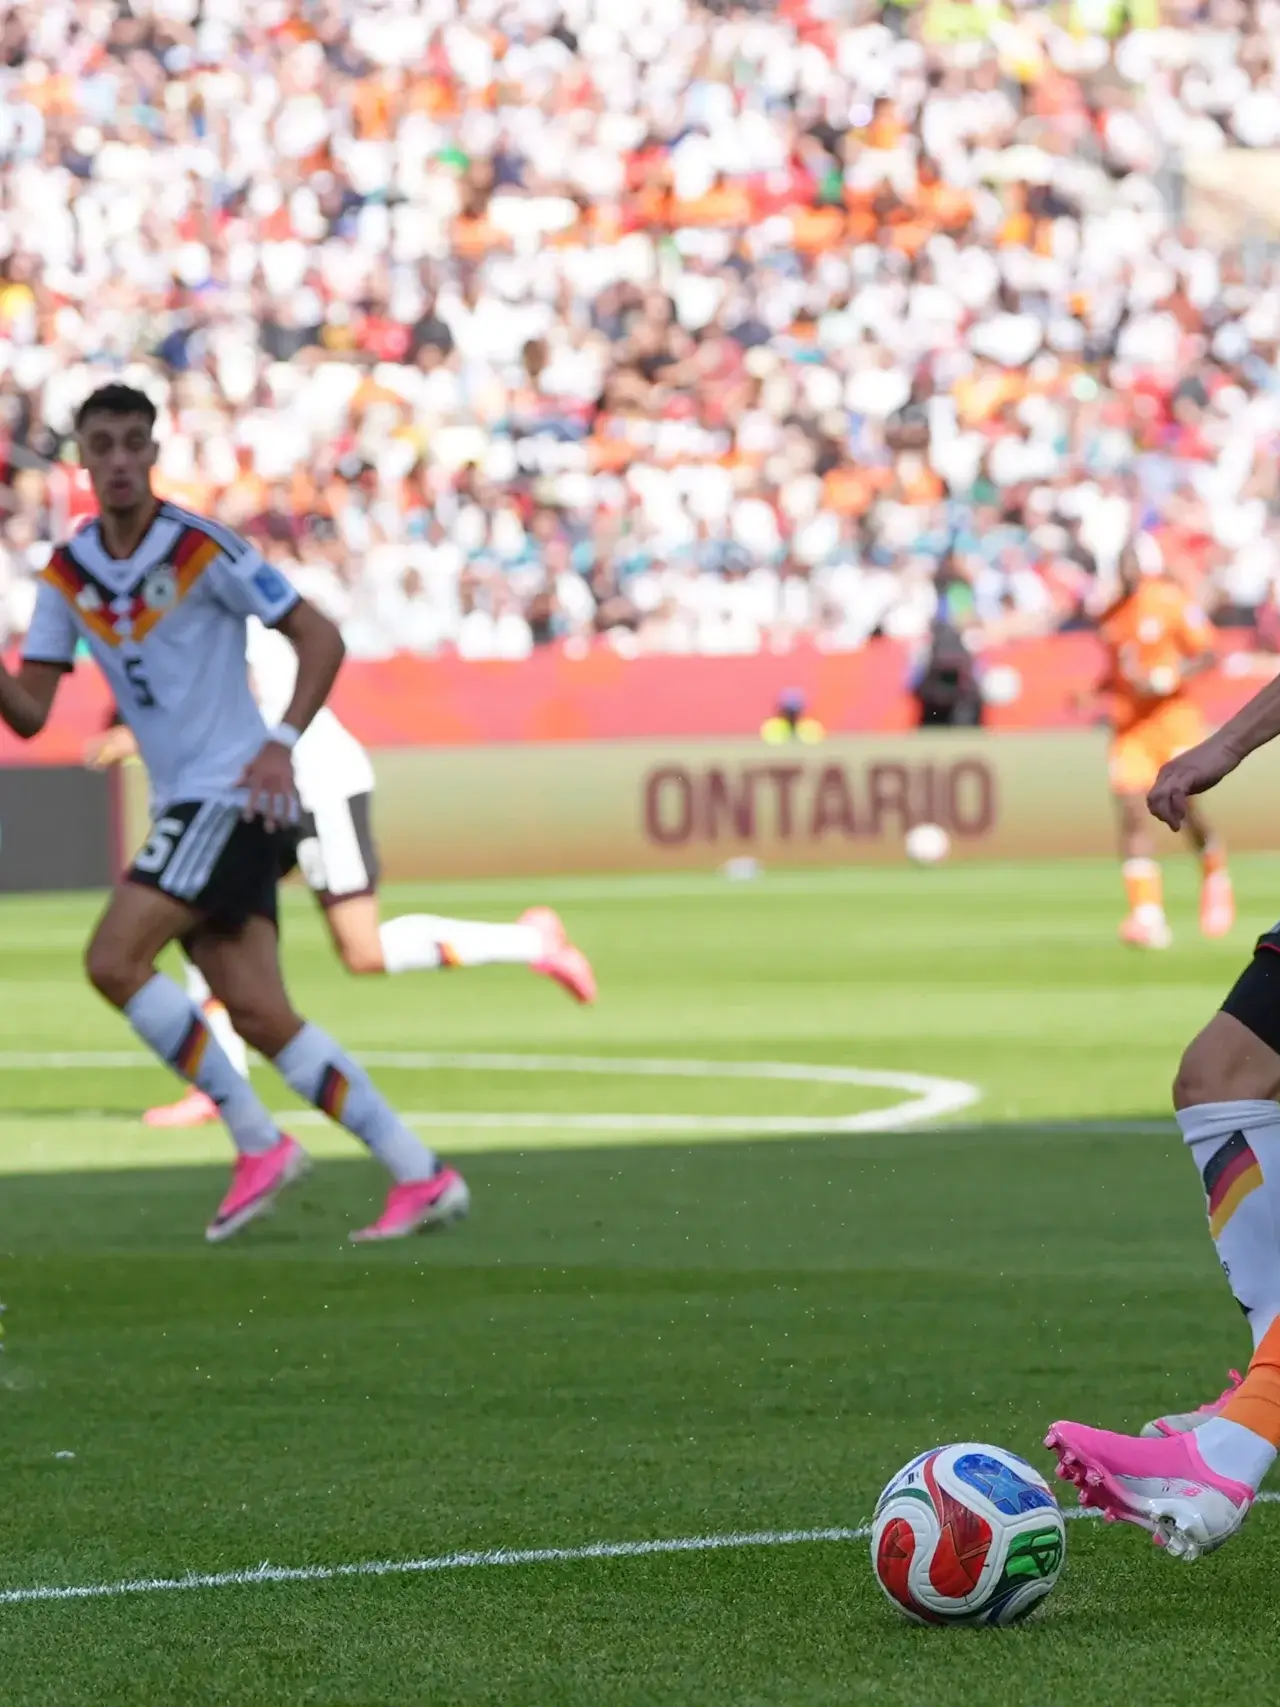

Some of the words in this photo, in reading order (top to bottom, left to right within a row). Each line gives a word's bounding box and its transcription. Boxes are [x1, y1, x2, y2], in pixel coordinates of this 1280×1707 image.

[123, 656, 155, 707] 5
[643, 757, 997, 847] ONTARIO
[135, 817, 183, 873] 5
